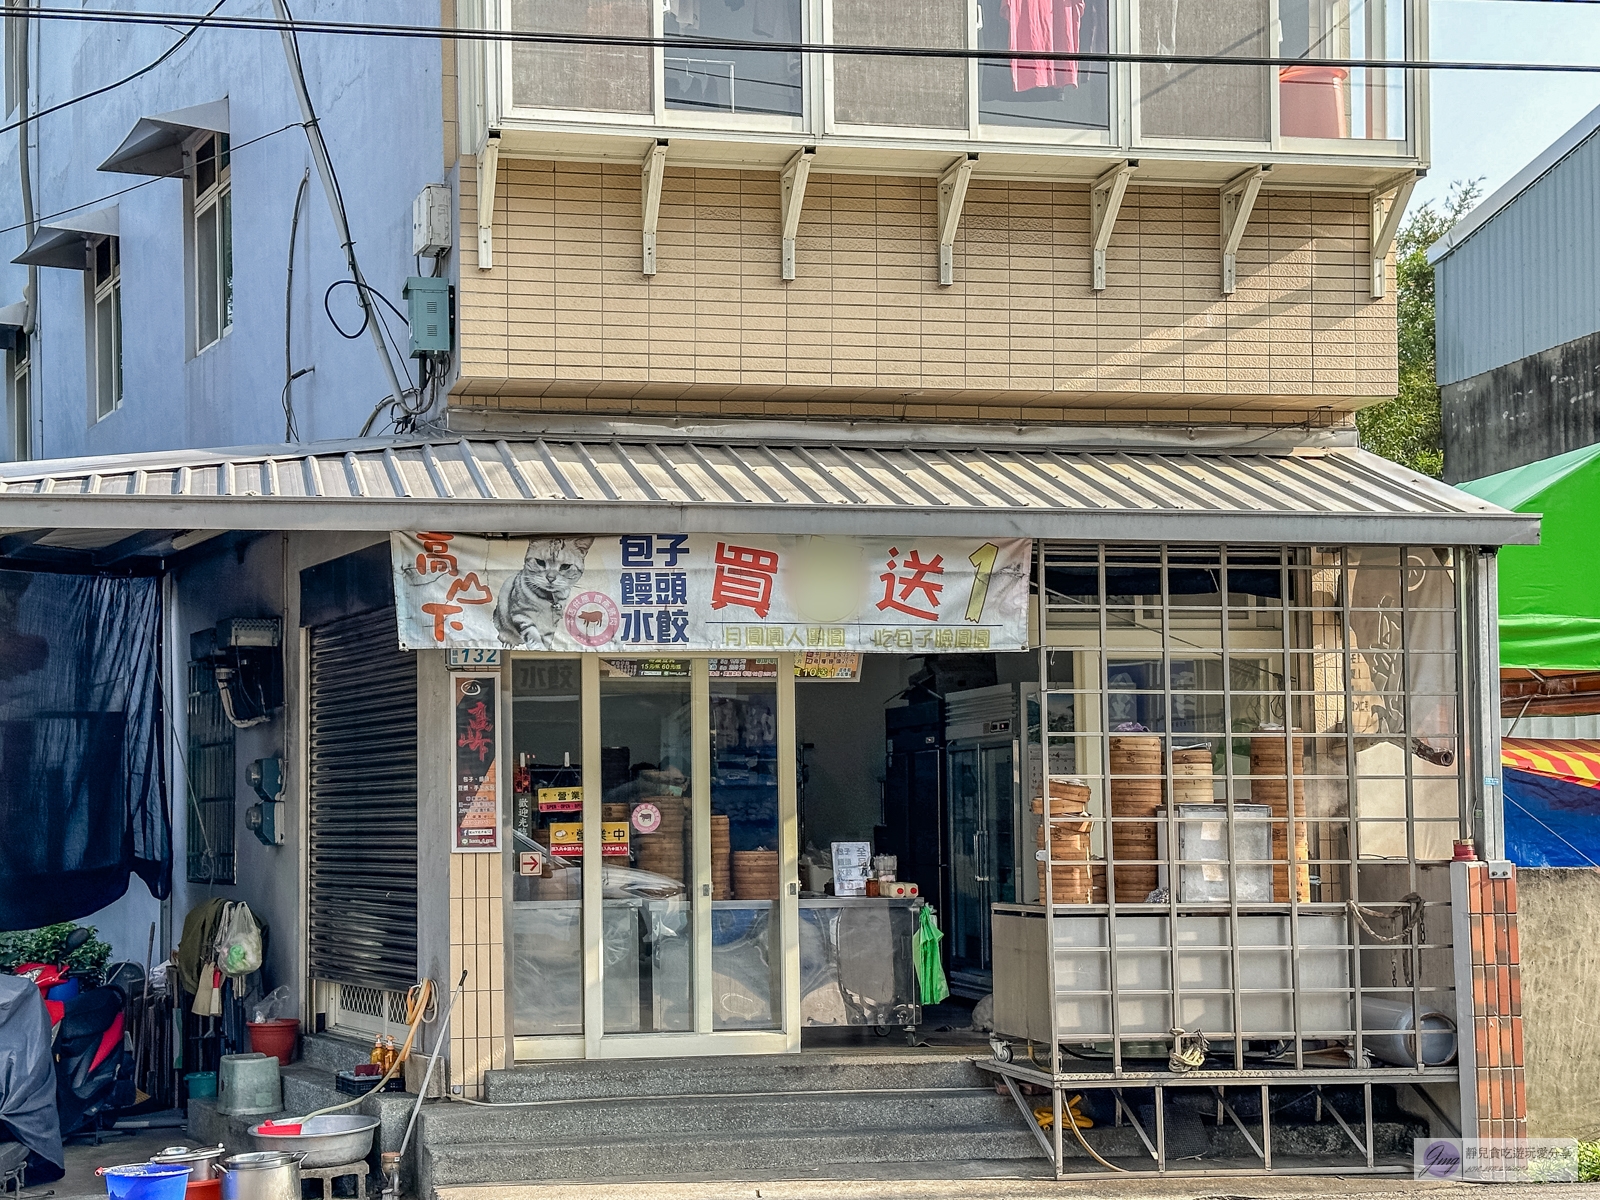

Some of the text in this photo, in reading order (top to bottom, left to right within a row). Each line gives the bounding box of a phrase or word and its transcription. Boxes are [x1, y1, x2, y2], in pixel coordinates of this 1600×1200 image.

[620, 534, 689, 567] 包子
[620, 572, 687, 605] 饅頭
[711, 541, 779, 619] 買
[621, 609, 689, 643] 水餃
[725, 626, 990, 648] 月圓圓人團圓 吃包子臉圓圓
[461, 649, 497, 663] 132
